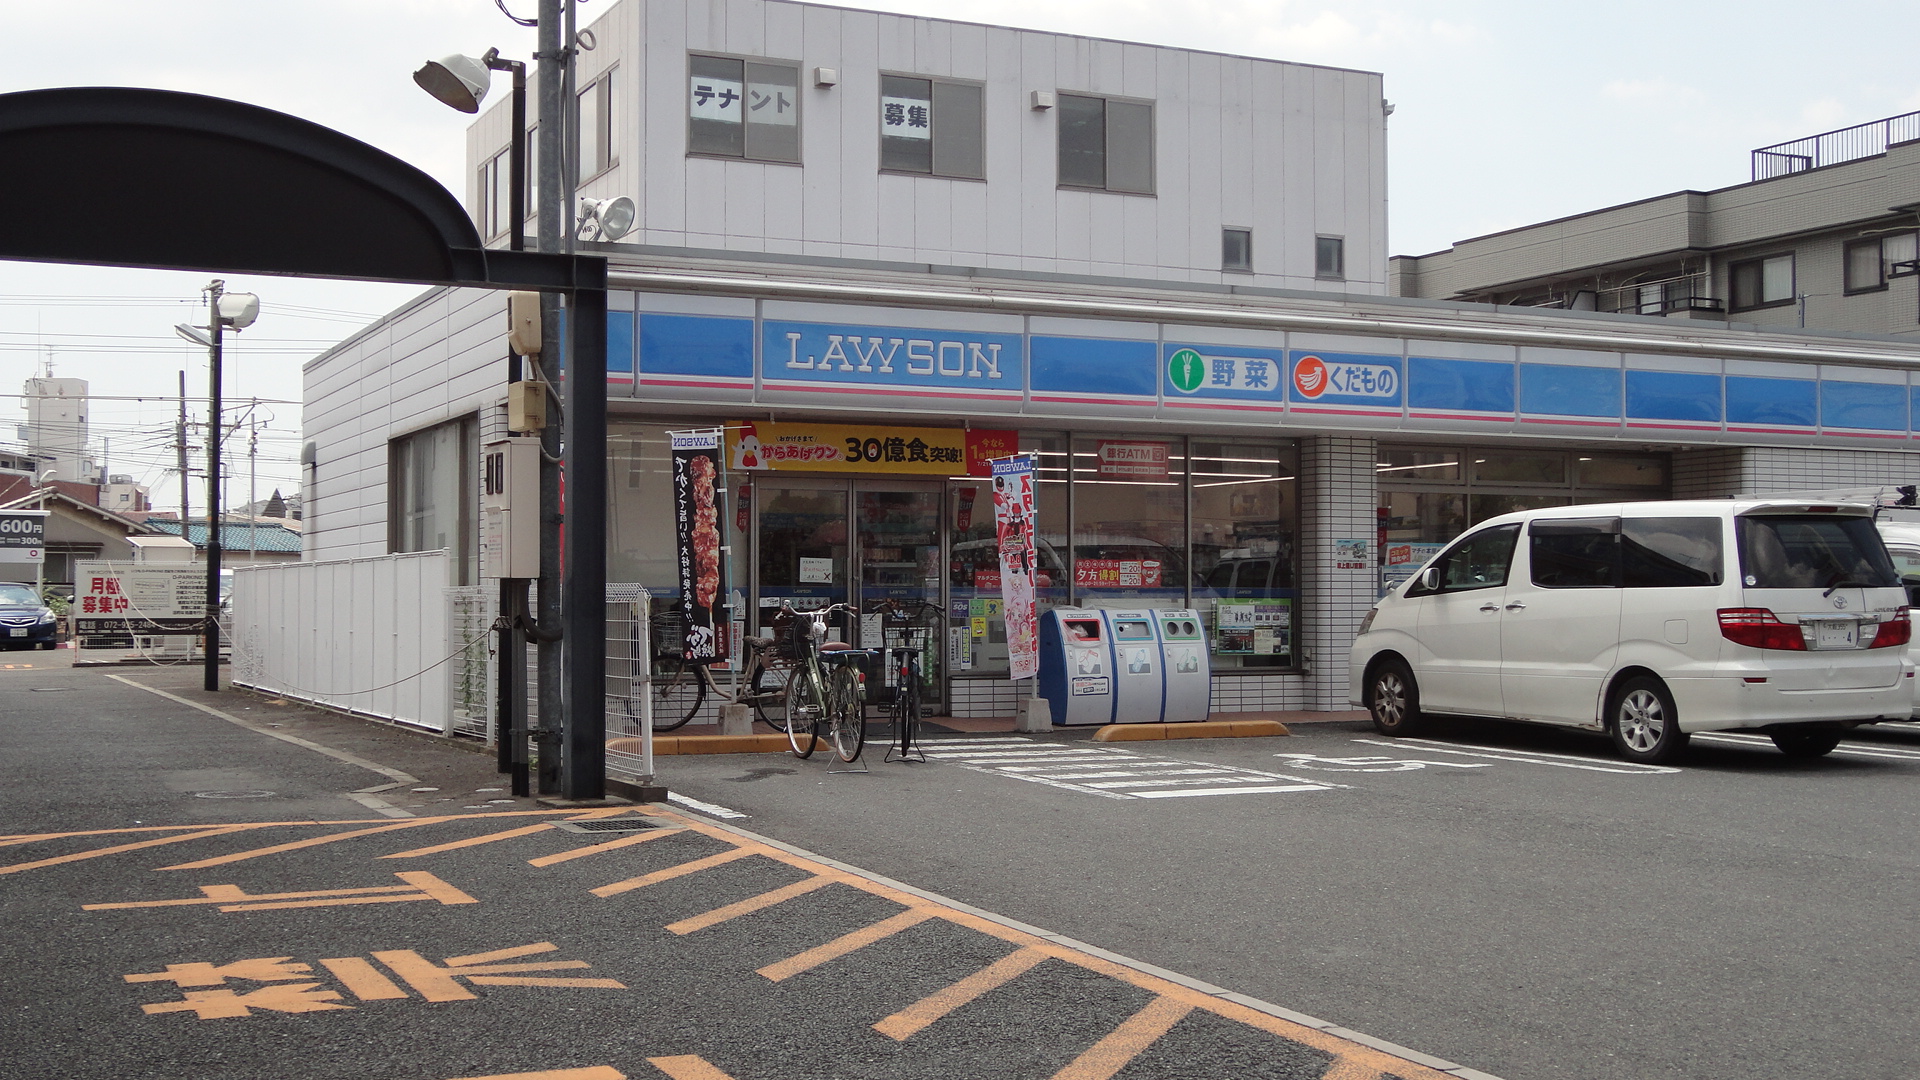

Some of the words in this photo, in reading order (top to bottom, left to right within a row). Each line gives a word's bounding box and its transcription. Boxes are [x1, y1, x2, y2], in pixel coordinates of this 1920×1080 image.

[694, 84, 791, 114] テナント
[884, 102, 928, 129] 募集
[785, 331, 1003, 380] LAWSON
[1211, 357, 1269, 388] 野菜
[1329, 366, 1395, 398] くだもの
[760, 443, 839, 461] からあげクン
[981, 438, 1005, 448] 今なら
[1107, 448, 1151, 460] 銀行ATM
[0, 519, 43, 534] 600円
[1077, 568, 1119, 581] 夕方得割
[82, 596, 129, 614] 募集中
[952, 603, 968, 611] SOS
